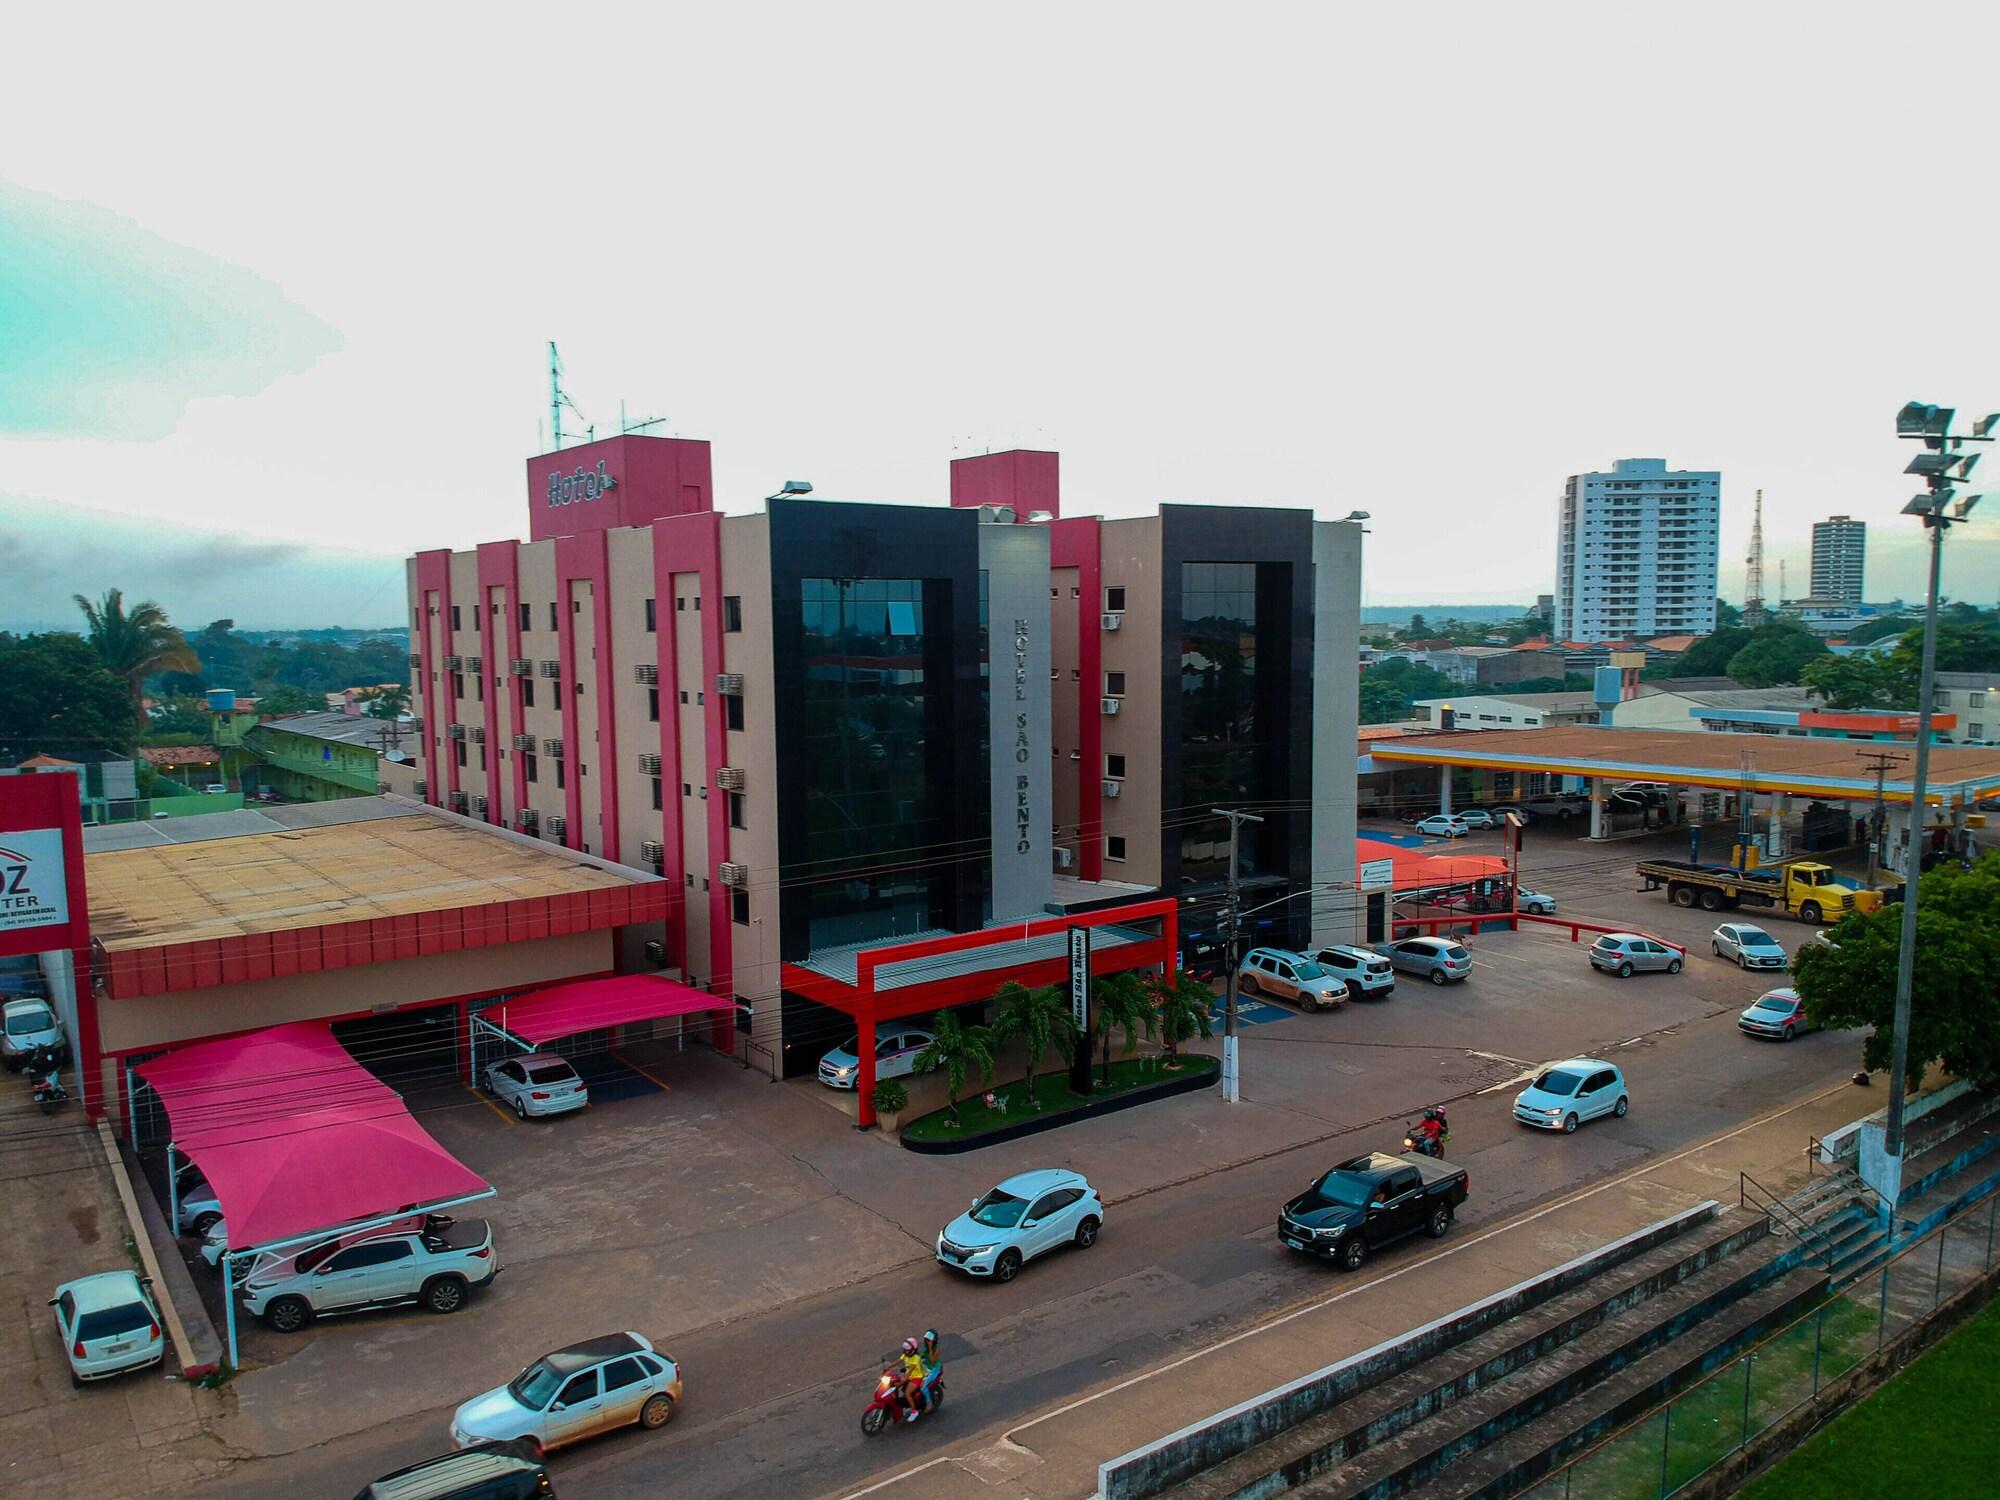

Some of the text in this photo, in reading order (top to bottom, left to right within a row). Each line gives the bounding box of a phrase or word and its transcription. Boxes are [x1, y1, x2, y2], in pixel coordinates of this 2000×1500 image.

[547, 459, 606, 508] Hotel
[1014, 619, 1030, 701] HOTEL
[1016, 775, 1031, 855] BENTO
